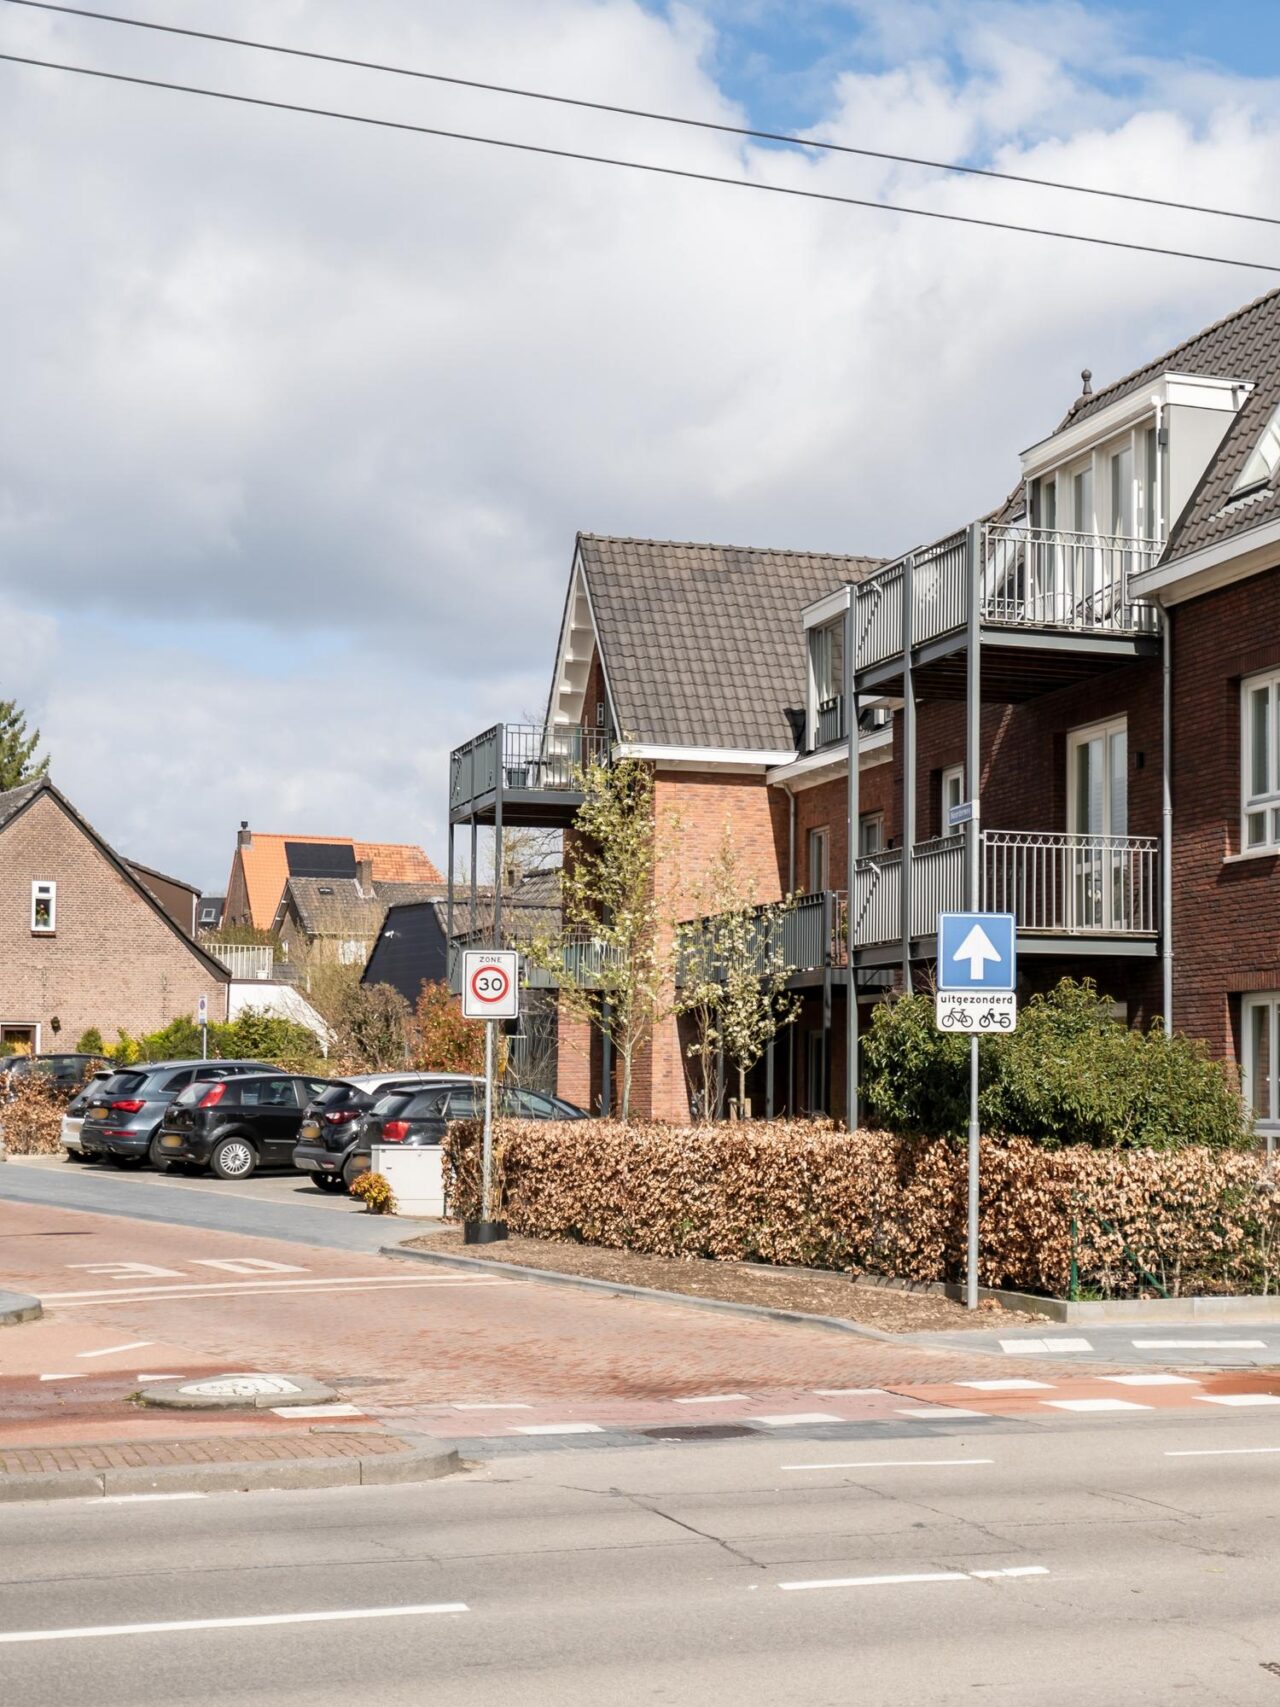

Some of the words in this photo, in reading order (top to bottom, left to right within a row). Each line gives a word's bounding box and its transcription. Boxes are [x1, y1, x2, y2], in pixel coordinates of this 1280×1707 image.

[479, 978, 502, 991] 30
[941, 995, 1013, 1006] uitgezonderd
[65, 1258, 312, 1279] 30
